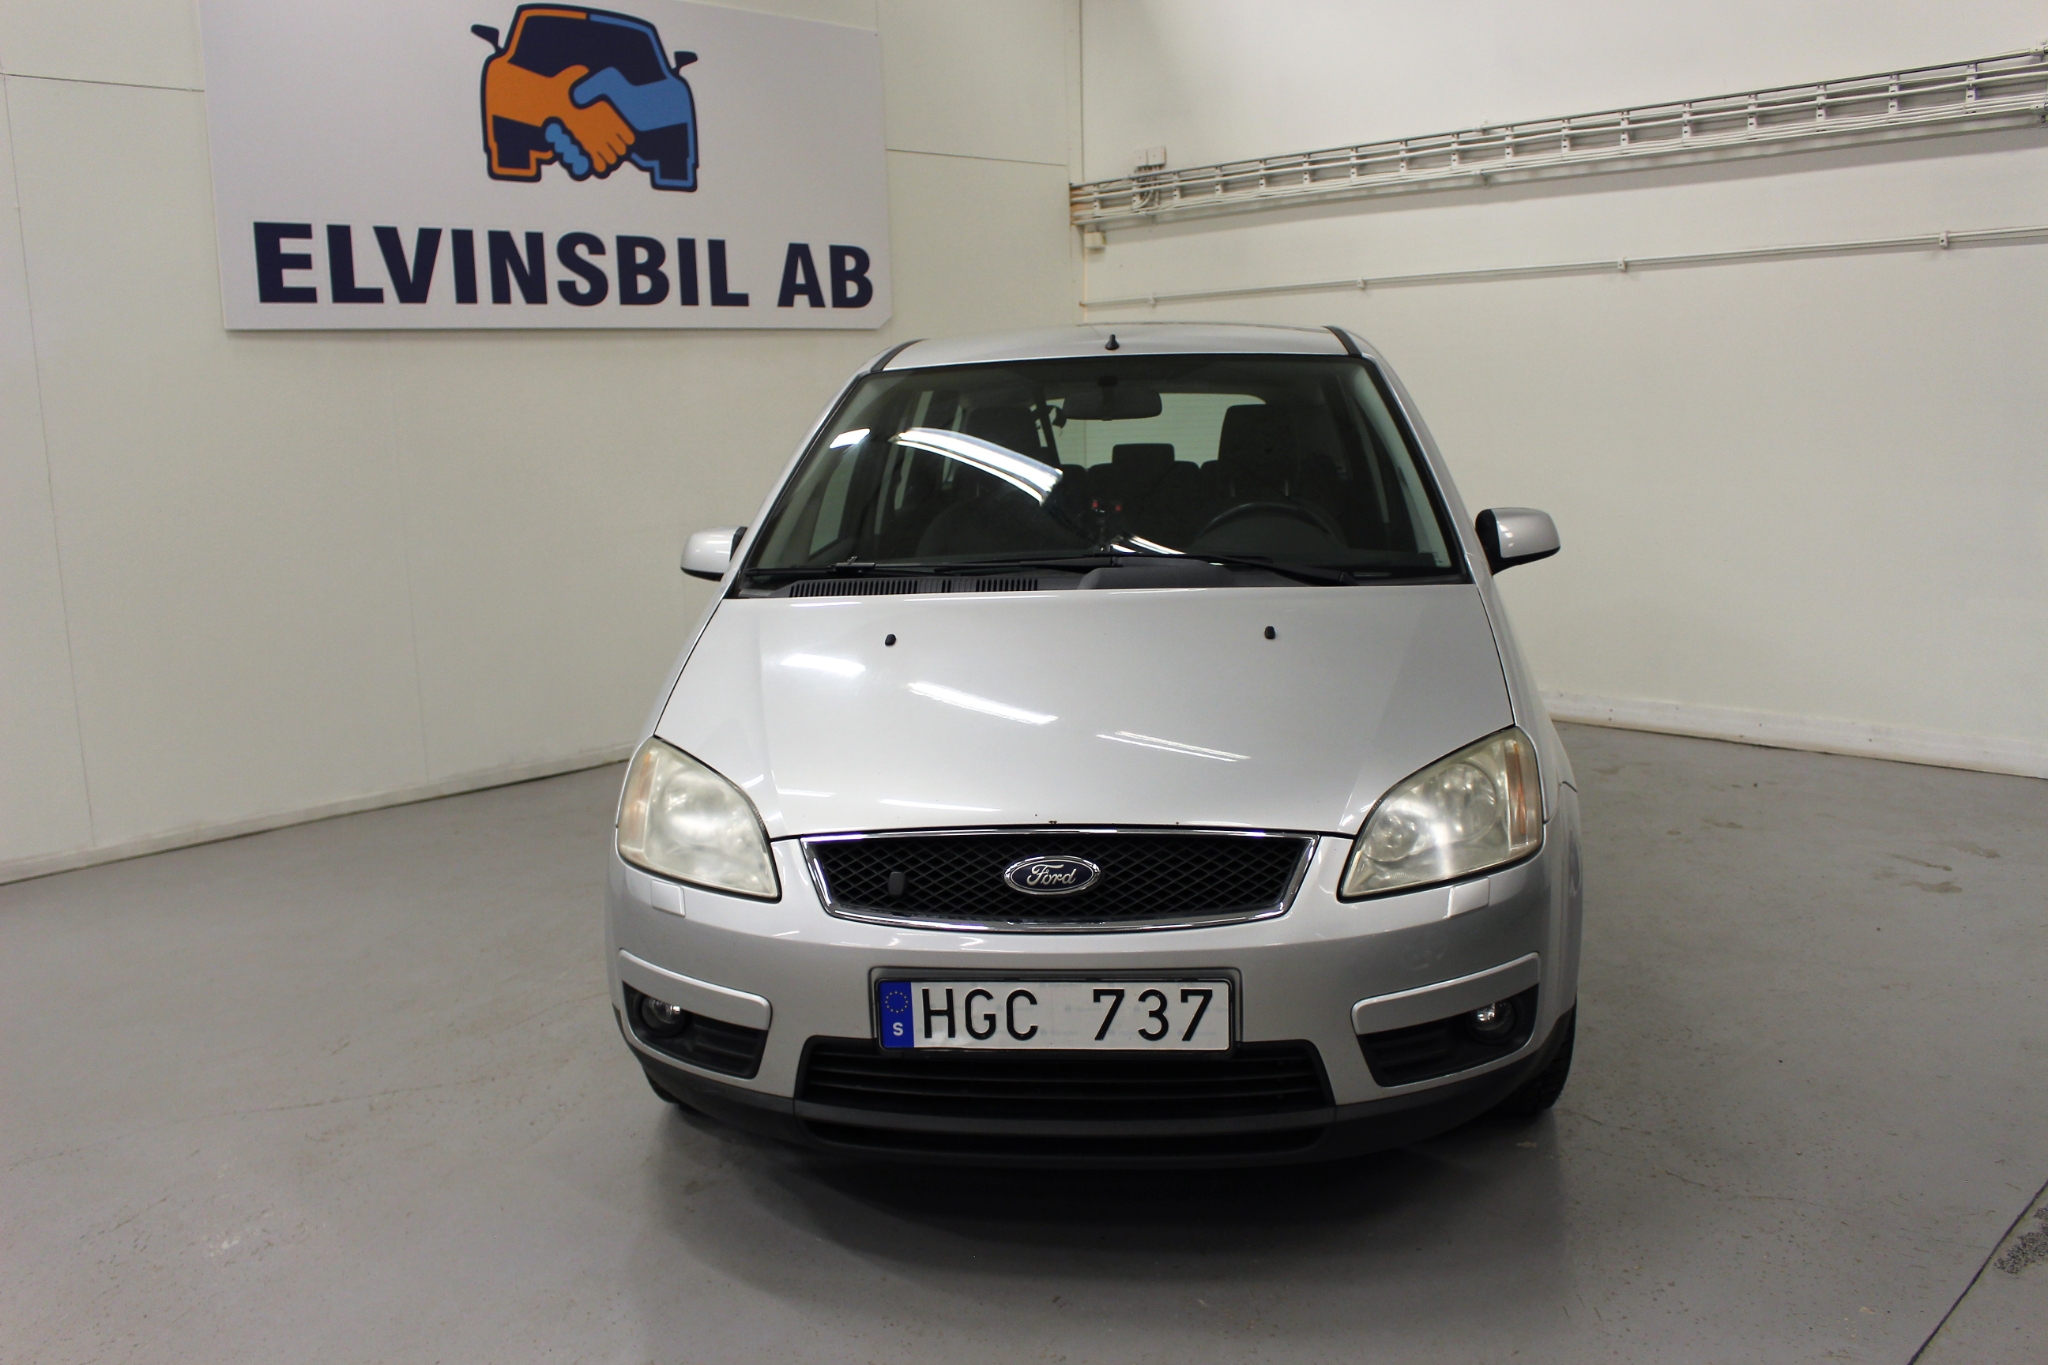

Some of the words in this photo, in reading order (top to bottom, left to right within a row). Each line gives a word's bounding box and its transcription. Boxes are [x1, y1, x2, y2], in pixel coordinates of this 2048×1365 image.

[253, 222, 749, 307] ELVINSBIL
[777, 242, 873, 308] AB
[1026, 864, 1077, 885] Ford
[893, 1022, 904, 1036] S
[921, 988, 1038, 1041] HGC
[1093, 988, 1213, 1041] 737
